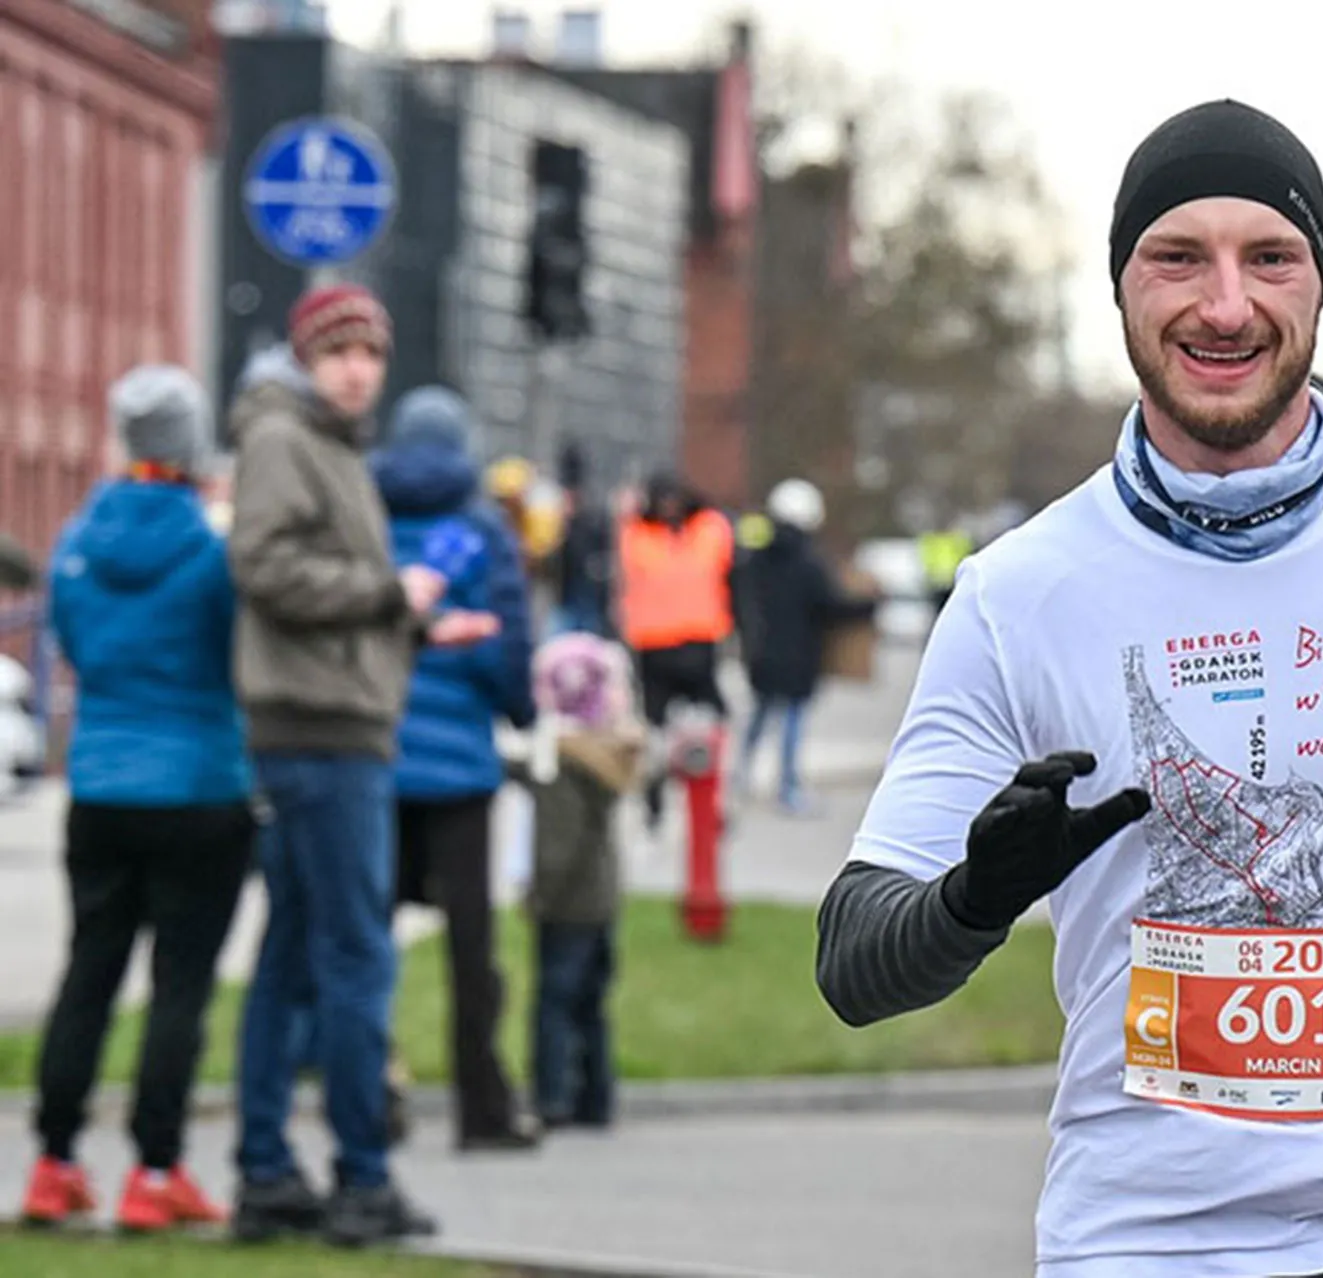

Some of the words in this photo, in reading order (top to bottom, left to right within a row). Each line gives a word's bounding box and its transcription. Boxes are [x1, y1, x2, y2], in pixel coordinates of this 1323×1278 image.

[1166, 629, 1261, 653] ENERGA
[1179, 651, 1262, 671] GDAŃSK
[1181, 667, 1264, 687] MARATON
[1297, 690, 1318, 711] w
[1239, 940, 1263, 956] 06
[1239, 957, 1263, 973] 04
[1136, 1006, 1168, 1046] C
[1246, 1057, 1322, 1075] MARCIN
